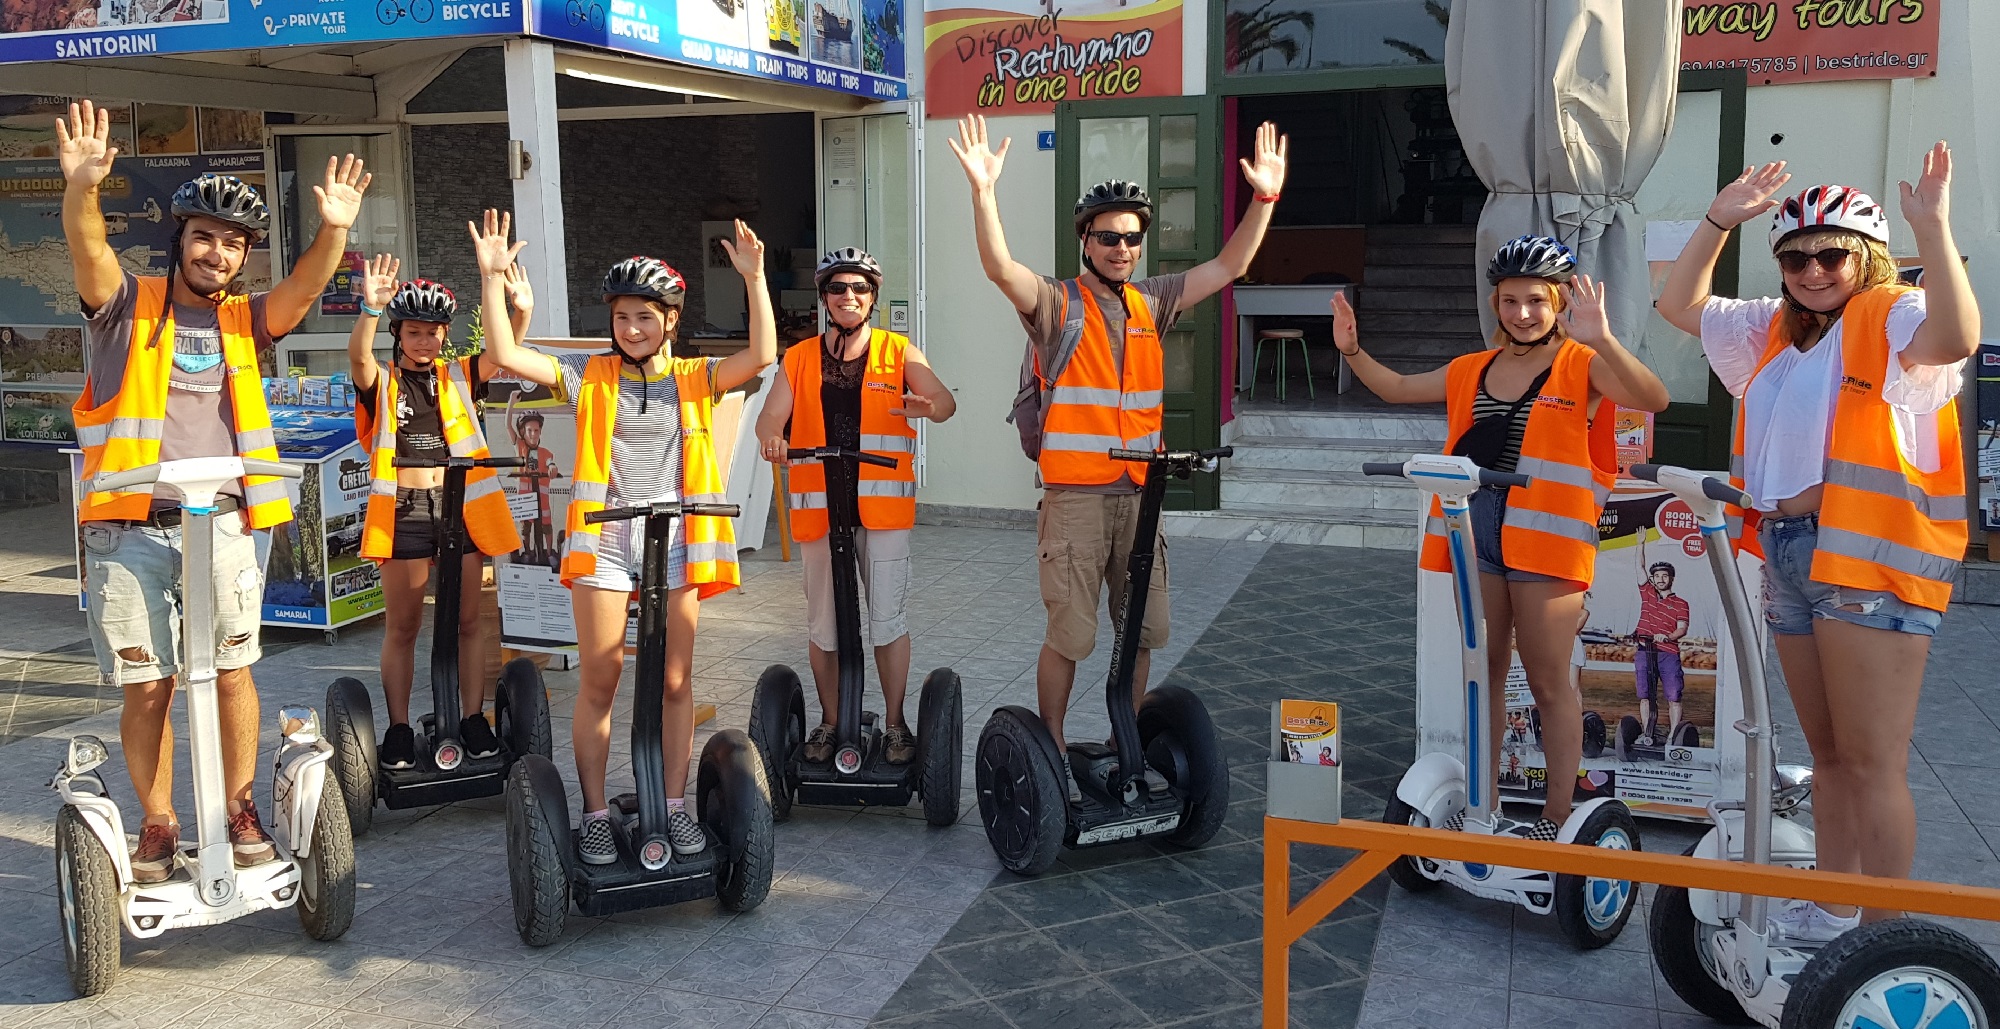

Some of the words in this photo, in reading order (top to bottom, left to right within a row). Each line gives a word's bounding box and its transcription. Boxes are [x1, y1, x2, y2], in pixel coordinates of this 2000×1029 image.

[442, 2, 511, 20] BICYCLE
[289, 11, 346, 27] PRIVATE
[1685, 1, 1778, 41] way
[1793, 0, 1924, 29] tours
[322, 25, 346, 34] TOUR
[611, 15, 660, 44] BICYCLE
[956, 8, 1063, 62] Discover
[56, 33, 157, 58] SANTORINI
[681, 39, 713, 63] QUAD
[715, 47, 749, 70] SAFARI
[994, 28, 1154, 81] Rethymno
[1815, 51, 1928, 70] bestride.gr
[755, 55, 783, 76] TRAIN
[785, 62, 808, 80] TRIPS
[816, 68, 836, 87] BOAT
[840, 74, 860, 90] TRIPS
[977, 74, 1005, 107] in
[1014, 75, 1067, 103] one
[1079, 59, 1141, 97] ride
[873, 80, 898, 98] DIVING
[1045, 134, 1053, 147] 4
[144, 158, 191, 168] FALASARNA
[208, 157, 245, 167] SAMARIA
[2, 178, 63, 191] UTDOOR
[1842, 376, 1872, 390] tRide
[21, 430, 49, 439] LOUTRO
[52, 431, 67, 440] BAY
[344, 493, 356, 501] LAND
[358, 490, 369, 499] ROVE
[1599, 515, 1618, 525] MNO
[1665, 511, 1692, 521] BOOK
[275, 609, 307, 619] SAMARIA
[1286, 716, 1329, 727] BestRide
[1523, 767, 1546, 781] seg
[1622, 767, 1693, 779] www.bestride.gr
[1088, 816, 1172, 841] SEGWA
